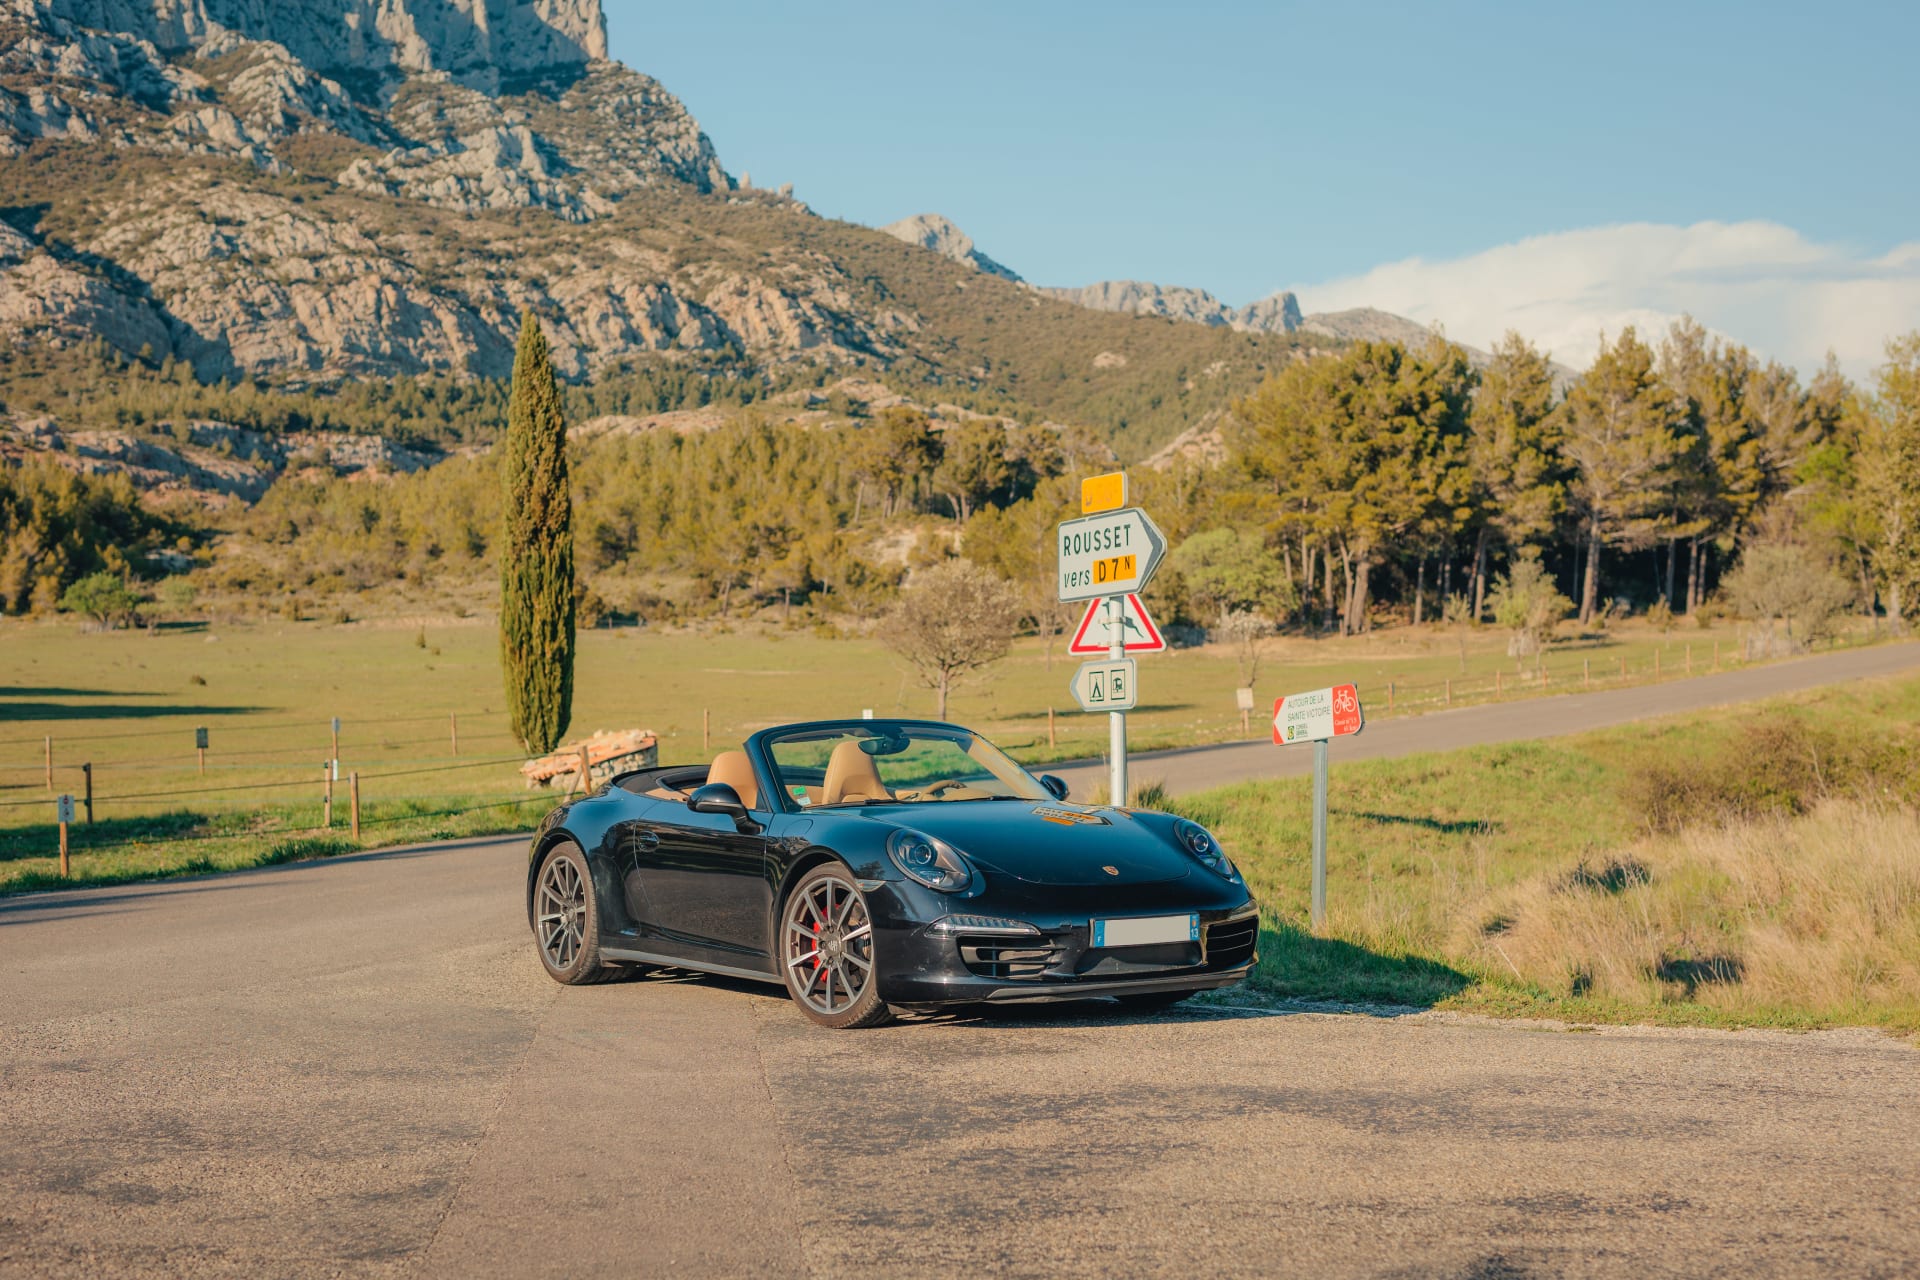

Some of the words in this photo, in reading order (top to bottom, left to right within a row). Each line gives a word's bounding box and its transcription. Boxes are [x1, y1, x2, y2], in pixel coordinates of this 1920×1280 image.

[1064, 524, 1131, 557] ROUSSET
[1064, 569, 1090, 588] vers
[1288, 697, 1309, 709] AUTOUR
[1309, 695, 1317, 704] DE
[1317, 694, 1325, 704] LA
[1288, 710, 1306, 721] SAINTE
[1306, 706, 1331, 719] VICTOIRE
[1190, 927, 1199, 938] 13
